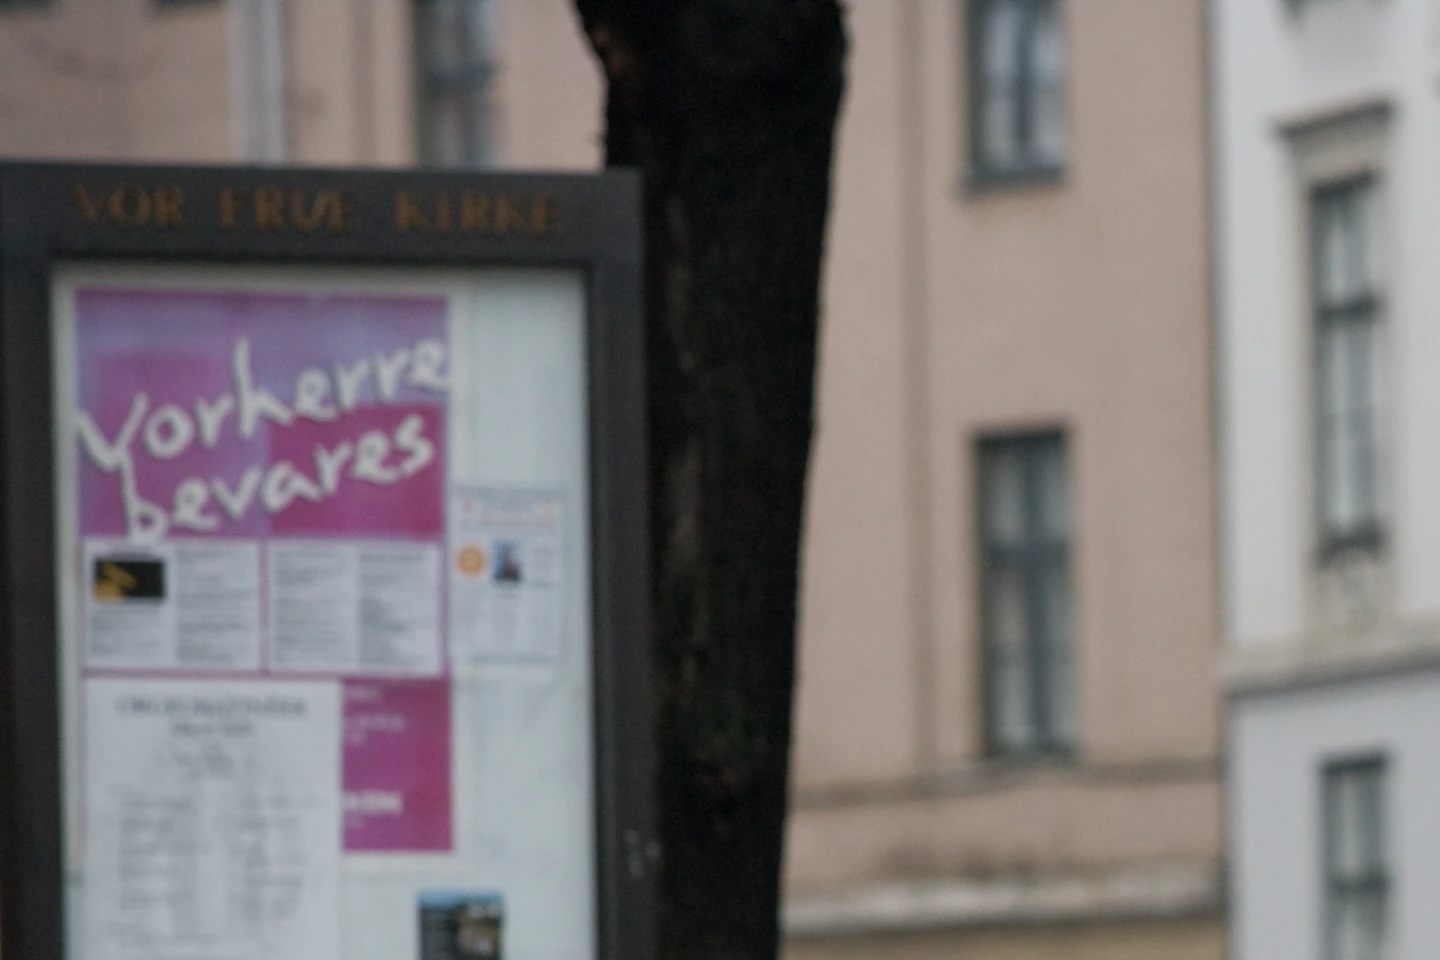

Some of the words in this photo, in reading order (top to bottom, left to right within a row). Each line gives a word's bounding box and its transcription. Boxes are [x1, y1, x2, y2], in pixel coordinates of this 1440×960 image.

[71, 184, 186, 230] VOR
[394, 188, 564, 236] KIRKE
[74, 336, 450, 472] Vorherre
[121, 411, 434, 546] bevares
